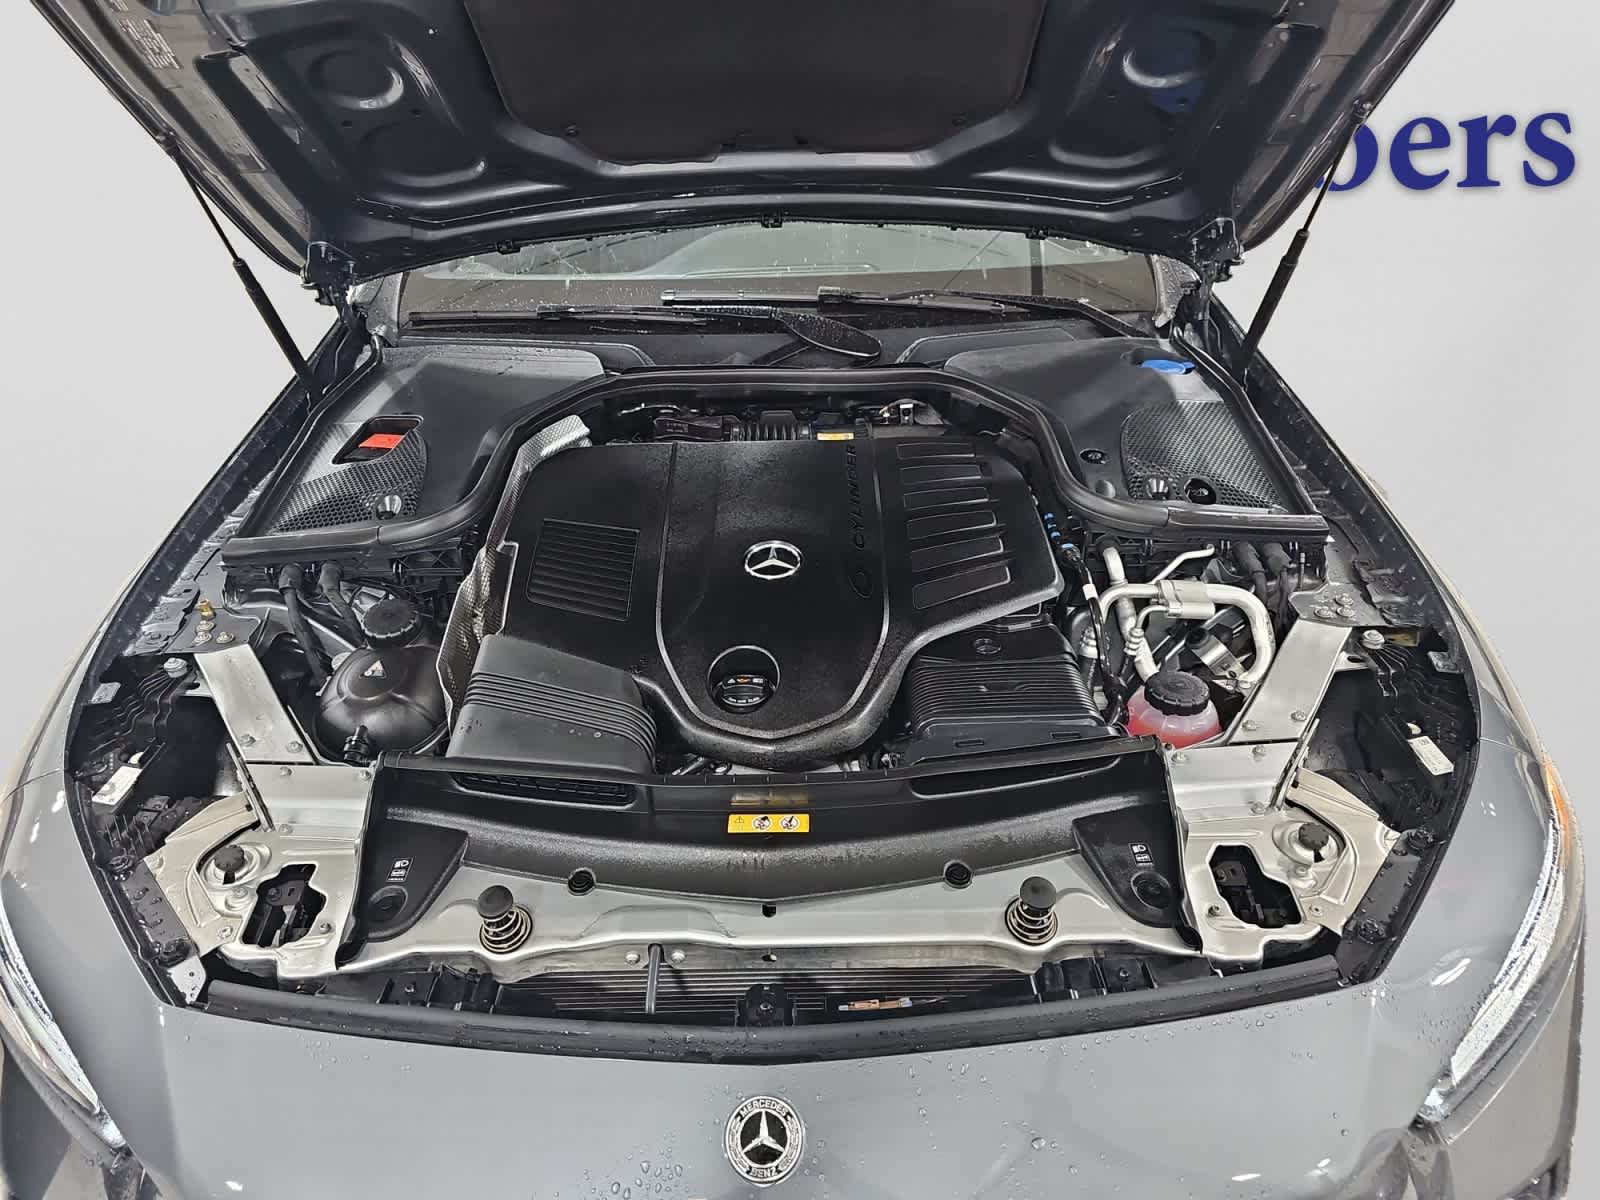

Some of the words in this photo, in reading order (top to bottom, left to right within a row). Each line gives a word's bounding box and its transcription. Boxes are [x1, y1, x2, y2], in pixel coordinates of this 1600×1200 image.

[846, 442, 865, 550] CYLINDER
[739, 1099, 789, 1117] MERCEDES
[750, 1167, 778, 1178] BENZ
